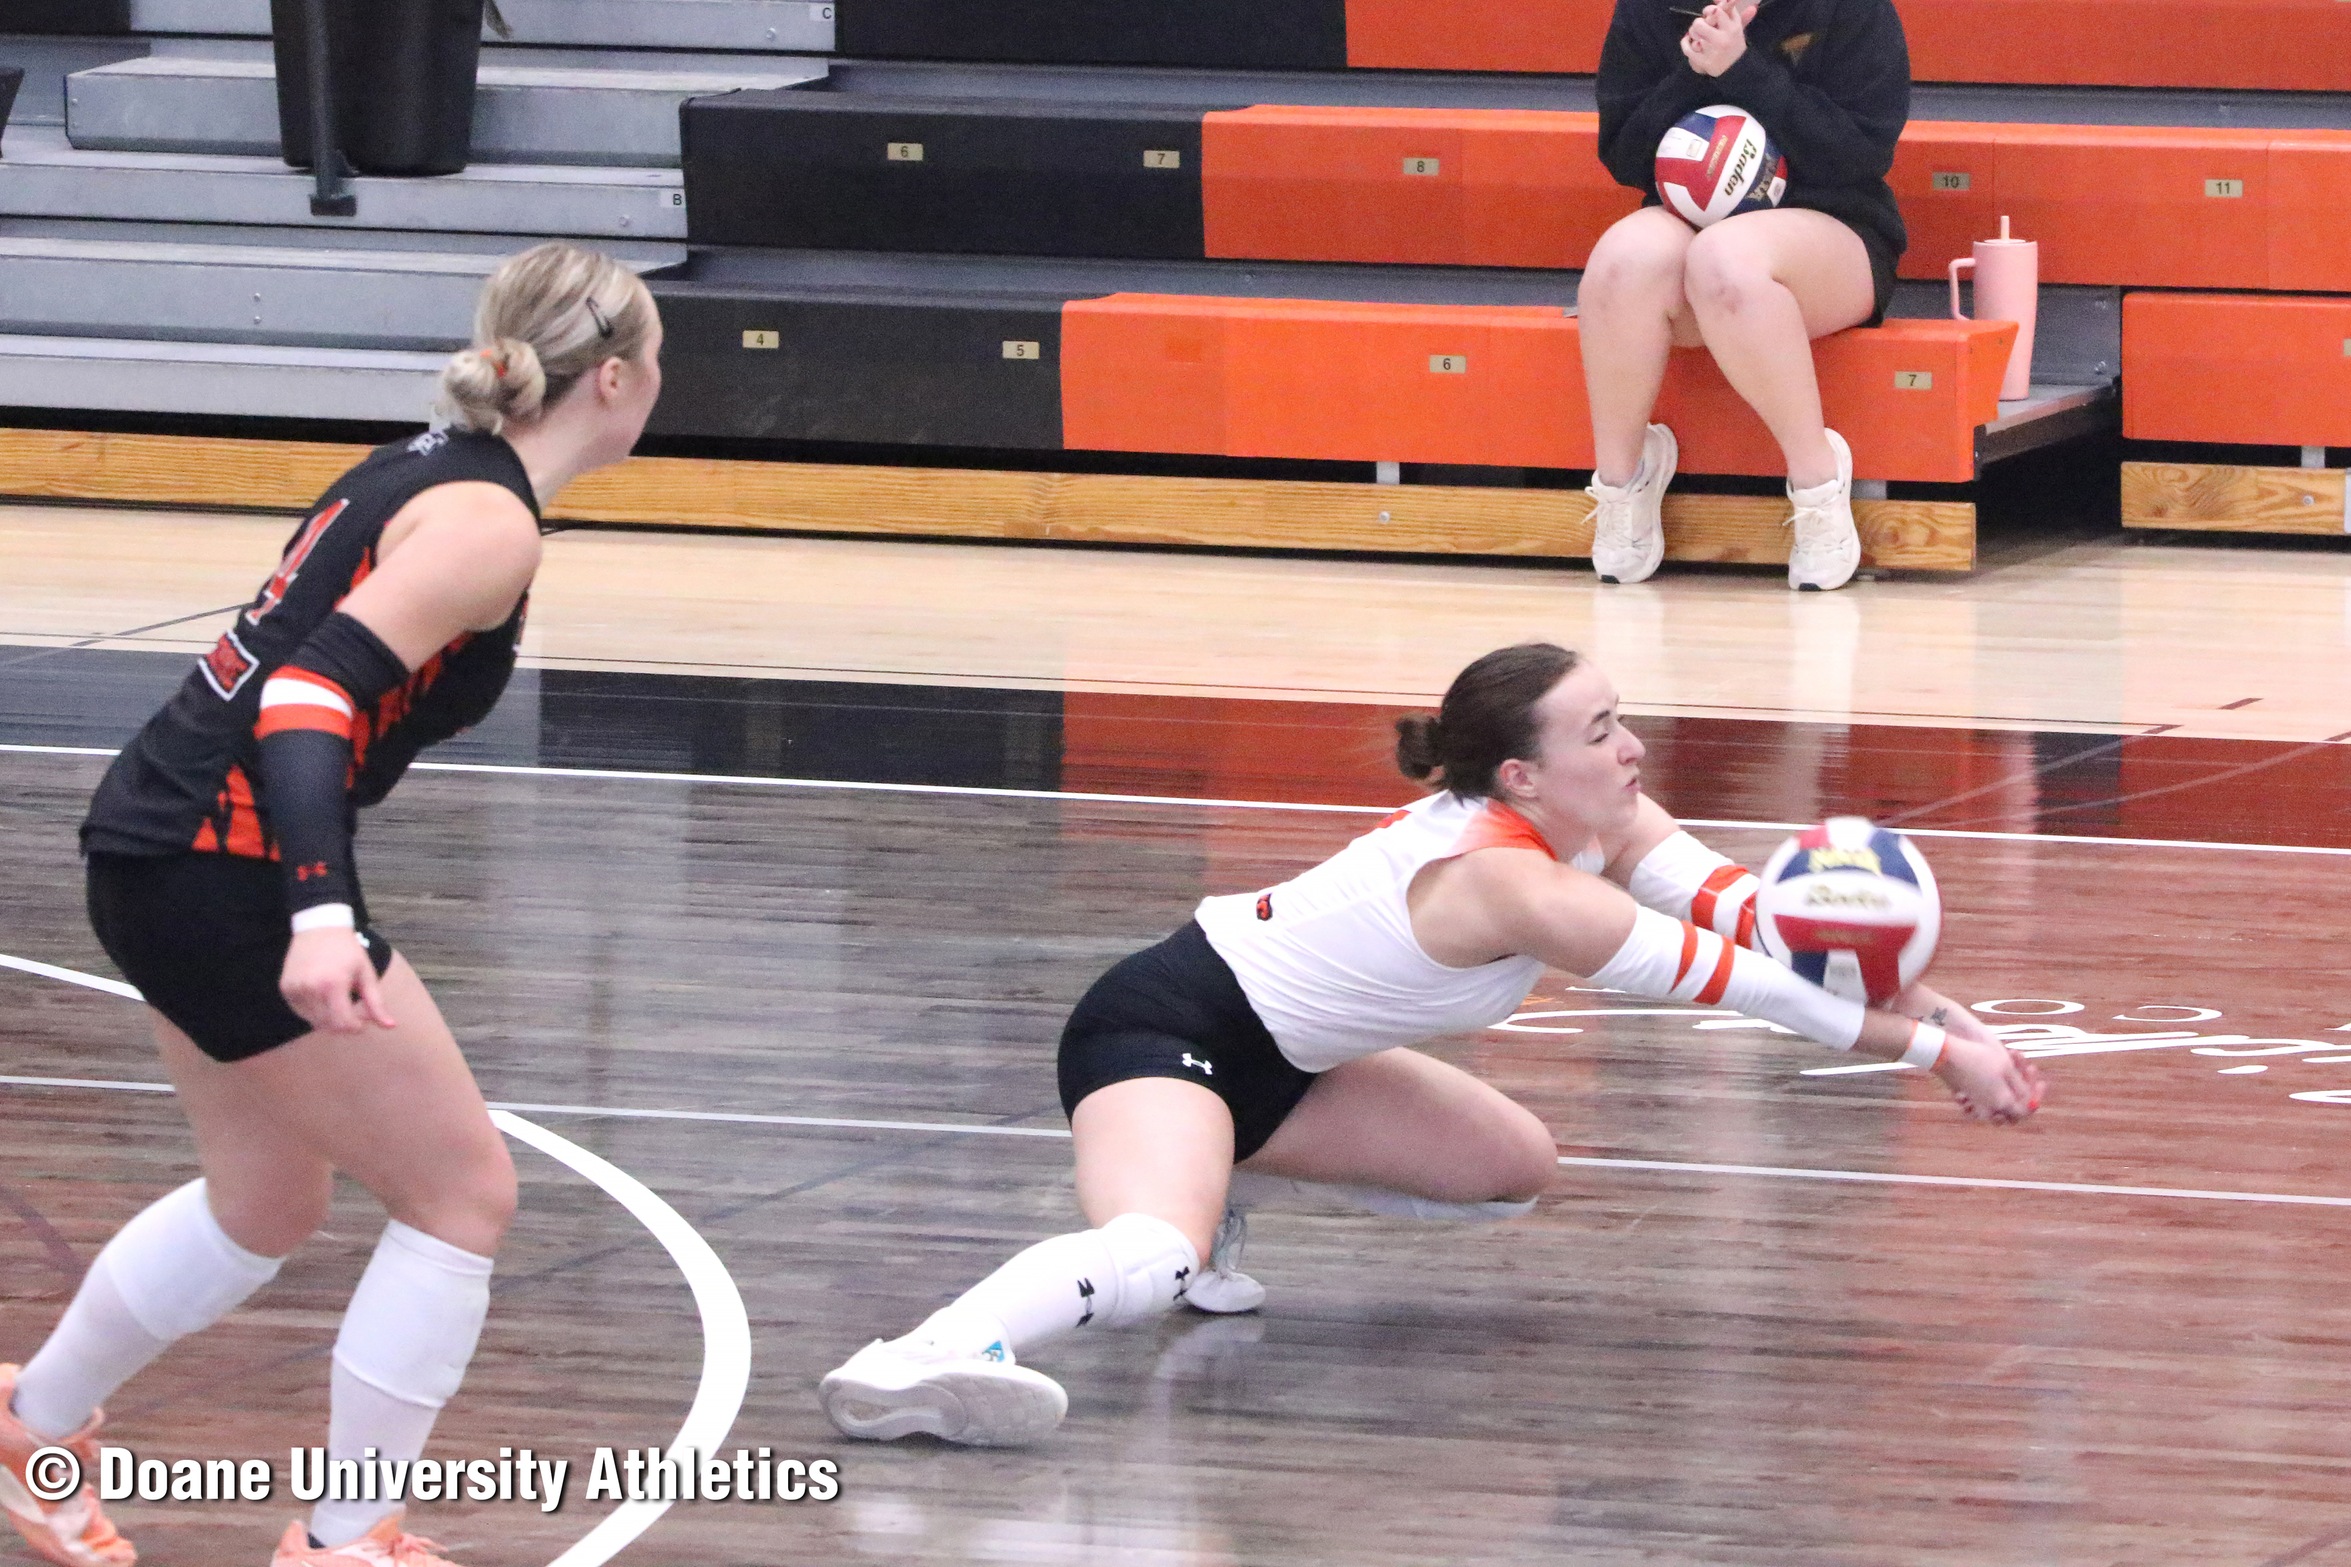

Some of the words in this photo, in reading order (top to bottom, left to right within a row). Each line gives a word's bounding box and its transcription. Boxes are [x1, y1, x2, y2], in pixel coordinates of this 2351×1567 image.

[822, 7, 832, 19] C
[900, 145, 909, 158] 6
[1157, 153, 1166, 165] 7
[1416, 160, 1425, 173] 8
[1724, 138, 1758, 196] Baden
[1942, 175, 1960, 188] 10
[2216, 182, 2230, 194] 11
[672, 193, 682, 206] B
[756, 333, 764, 345] 4
[1016, 344, 1025, 357] 5
[1442, 358, 1451, 370] 6
[1908, 374, 1917, 386] 7
